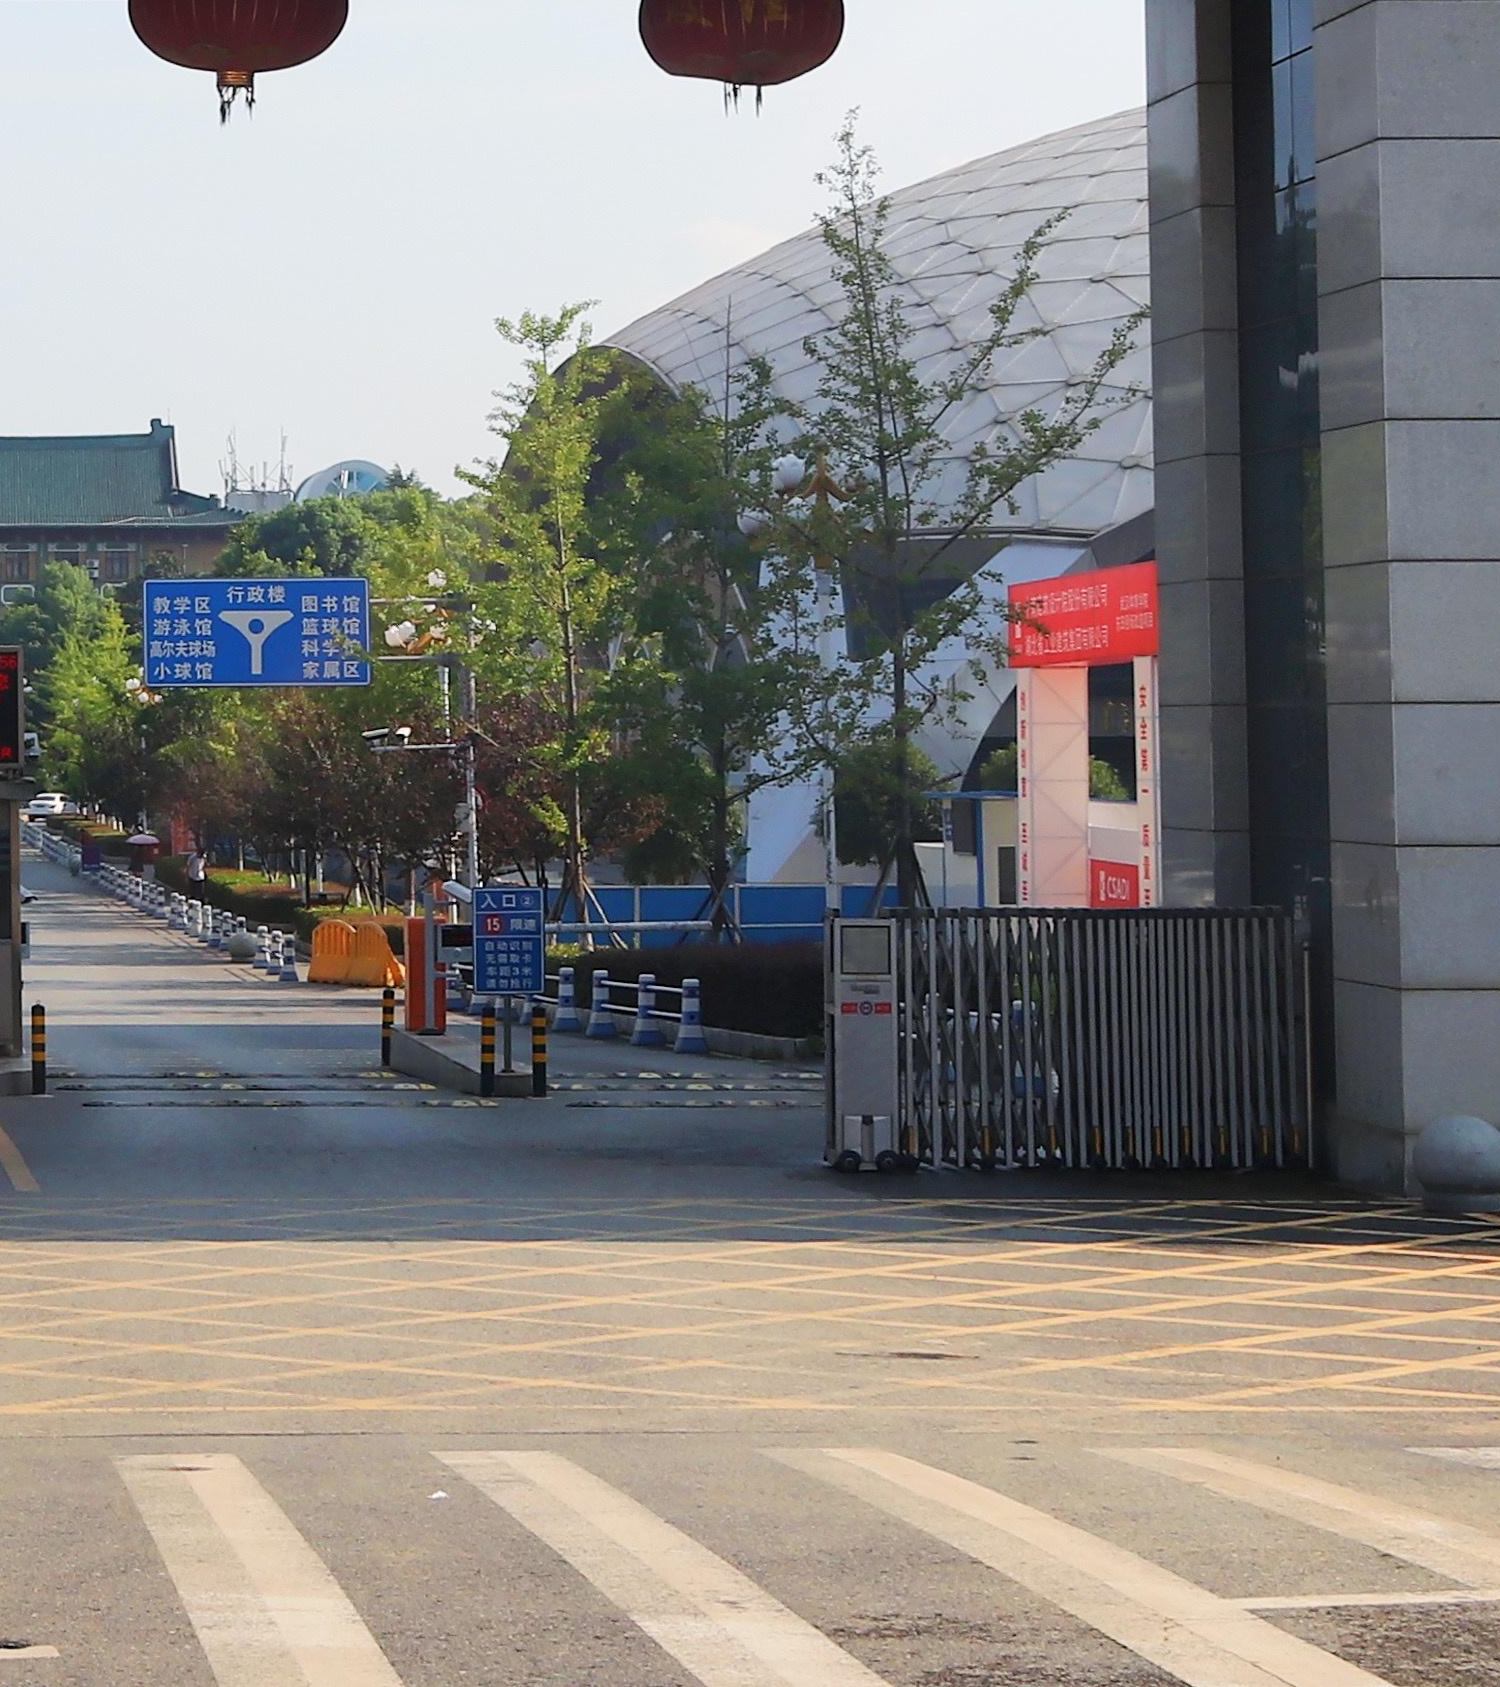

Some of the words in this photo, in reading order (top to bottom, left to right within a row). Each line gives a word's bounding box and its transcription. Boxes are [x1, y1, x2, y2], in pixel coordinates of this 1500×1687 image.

[226, 585, 286, 604] 行政楼
[153, 596, 212, 615] 教学区
[301, 595, 361, 614] 图书馆
[153, 618, 213, 637] 游泳馆
[301, 617, 361, 636] 篮球馆
[150, 640, 216, 658] 高尔夫球场
[153, 662, 214, 681] 小球馆
[302, 661, 361, 680] 家属区
[486, 917, 501, 932] 15
[510, 918, 537, 932] 限速
[484, 941, 533, 952] 自动识别
[485, 953, 532, 965] 无需取卡
[486, 966, 532, 977] 车距3米
